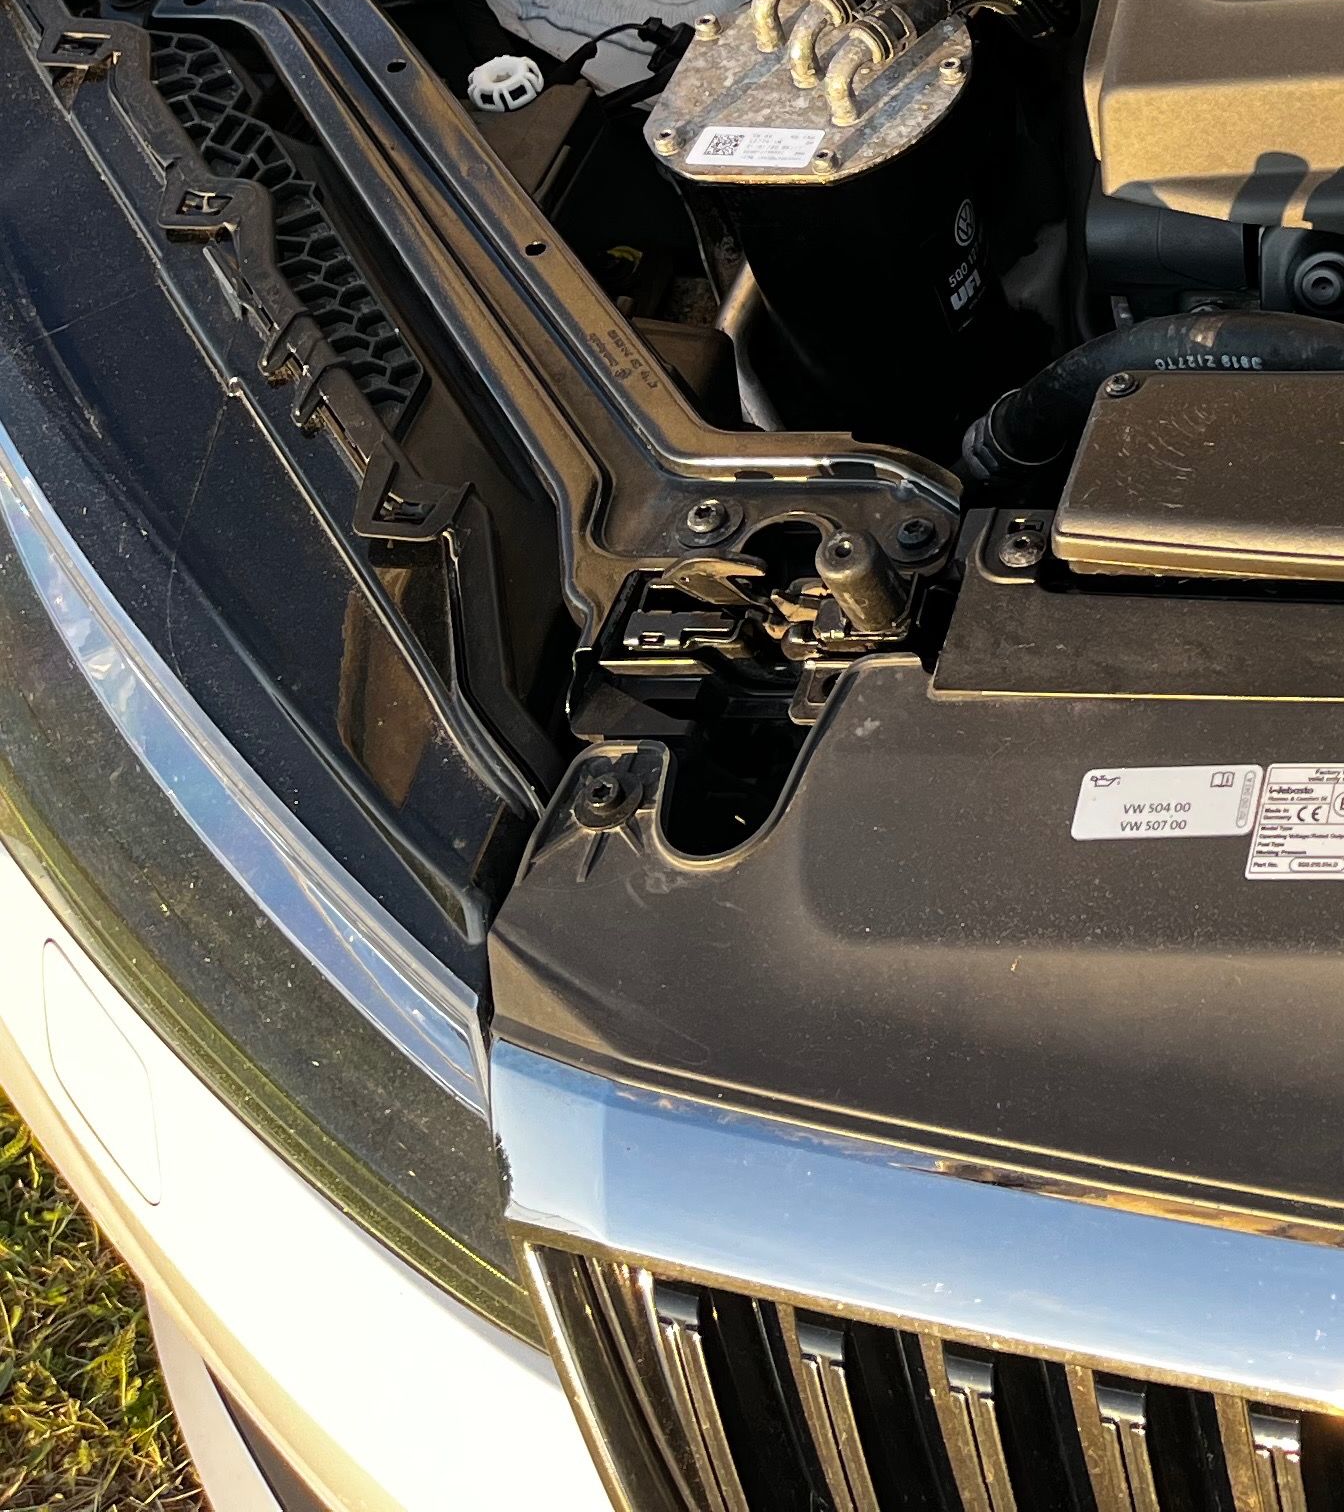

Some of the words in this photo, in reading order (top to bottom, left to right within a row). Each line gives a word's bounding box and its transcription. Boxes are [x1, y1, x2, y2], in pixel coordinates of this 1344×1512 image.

[950, 268, 981, 311] UFI
[1123, 804, 1146, 815] VW
[1148, 803, 1171, 813] 504
[1174, 802, 1191, 813] 00
[1120, 821, 1142, 831] VW
[1145, 820, 1167, 830] 507
[1170, 819, 1187, 830] 00
